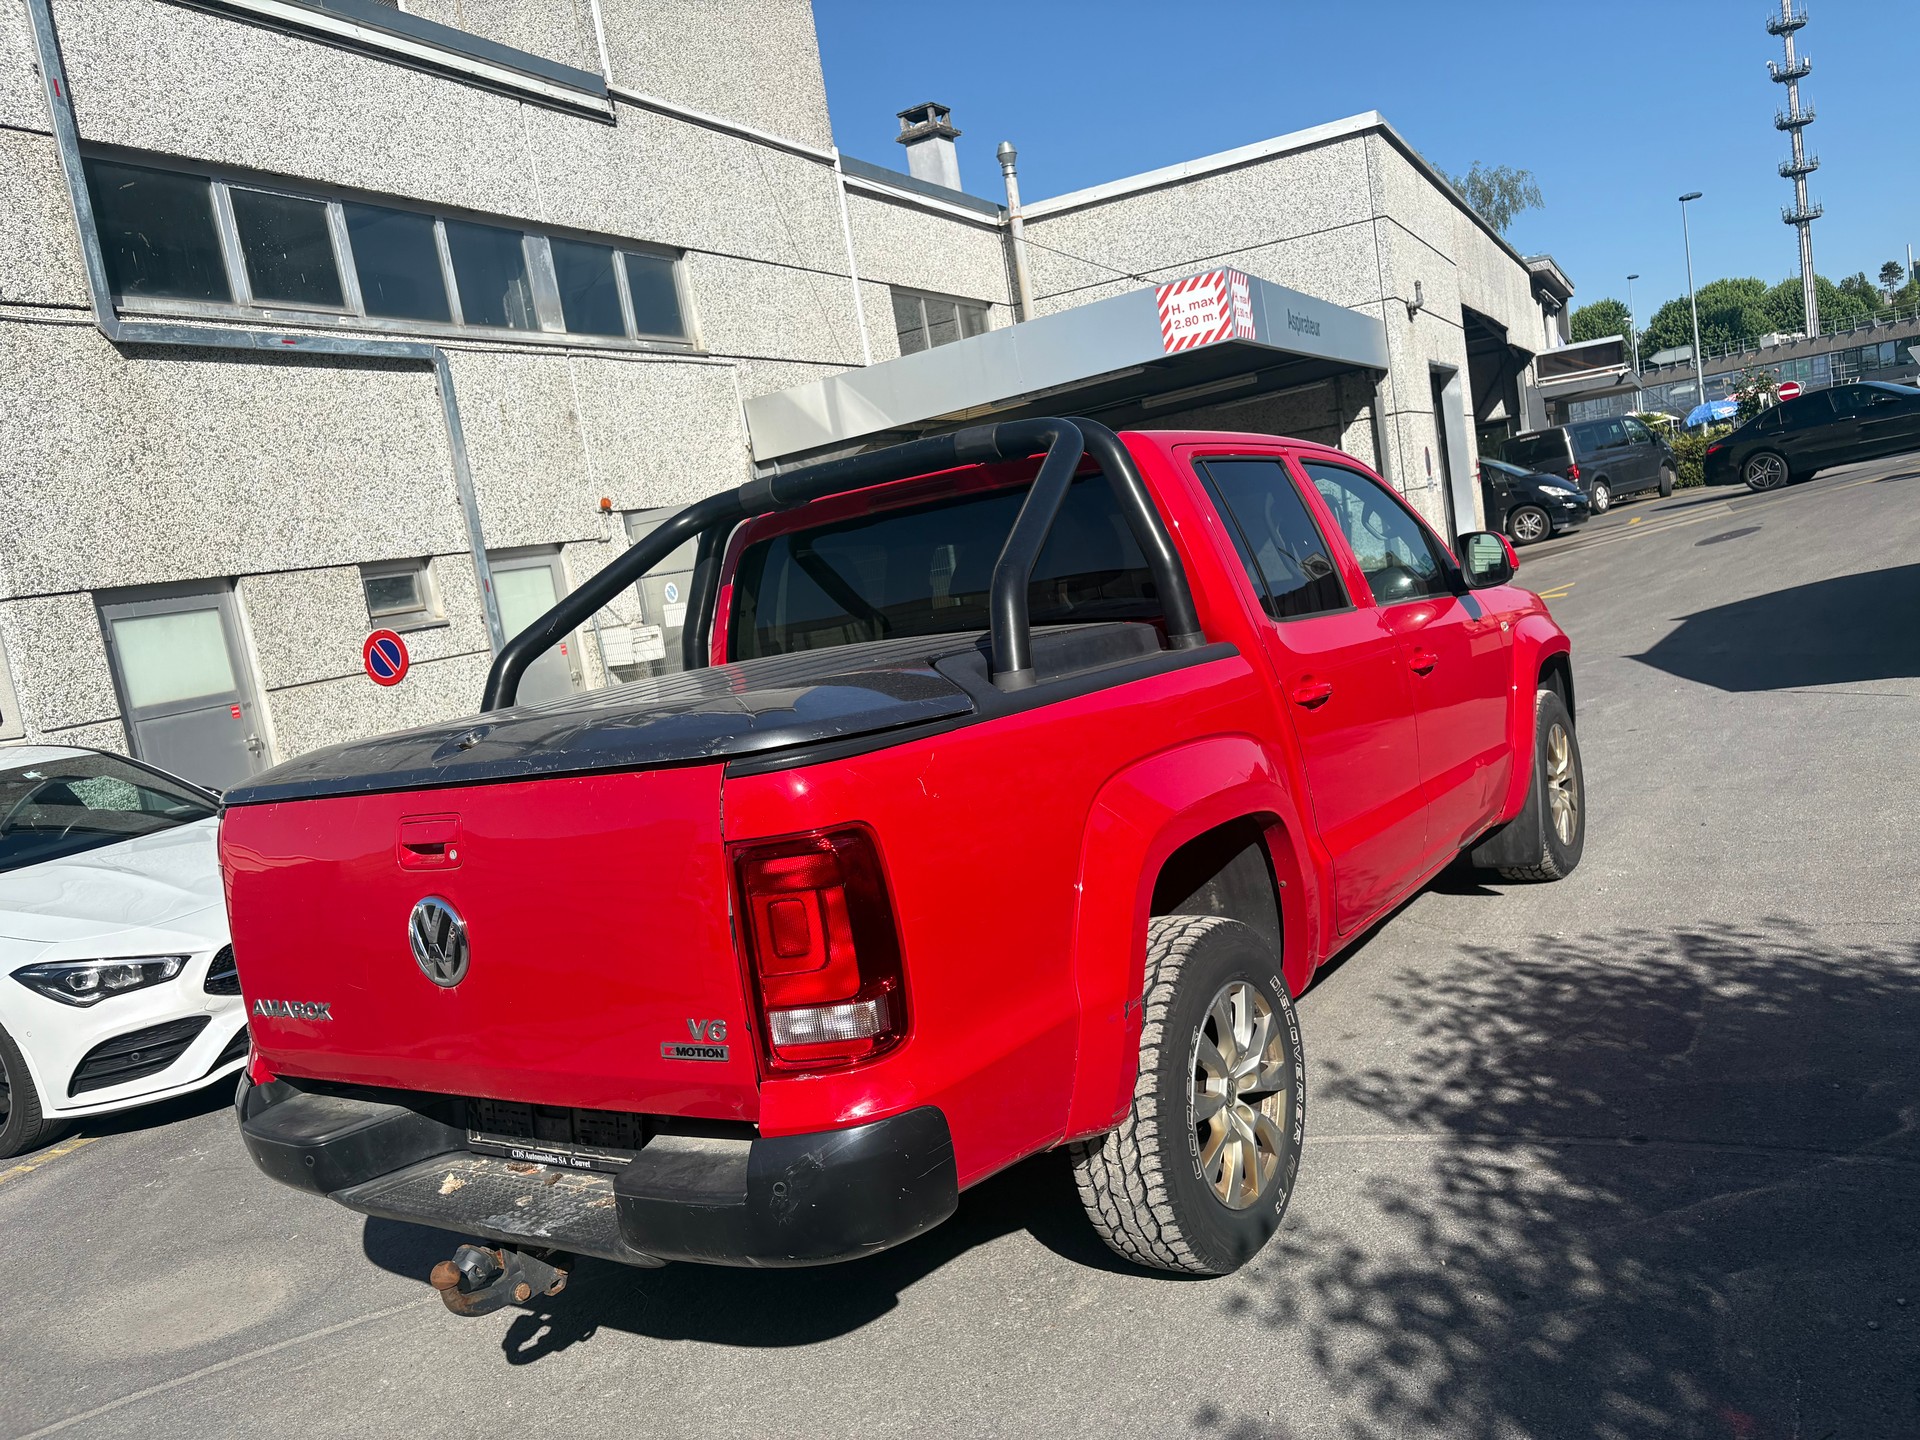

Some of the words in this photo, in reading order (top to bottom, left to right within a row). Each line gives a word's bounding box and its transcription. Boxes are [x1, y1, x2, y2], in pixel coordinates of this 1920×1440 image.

[1171, 303, 1185, 316] H.
[1188, 297, 1215, 311] max
[1174, 315, 1199, 330] 2.80
[1202, 312, 1218, 323] m.
[1287, 307, 1321, 337] Aspirateur
[252, 998, 333, 1021] AMAROK
[686, 1018, 728, 1042] V6
[1269, 975, 1305, 1146] DISCOVERER
[511, 1149, 525, 1159] CDS
[525, 1152, 558, 1165] Automobiles
